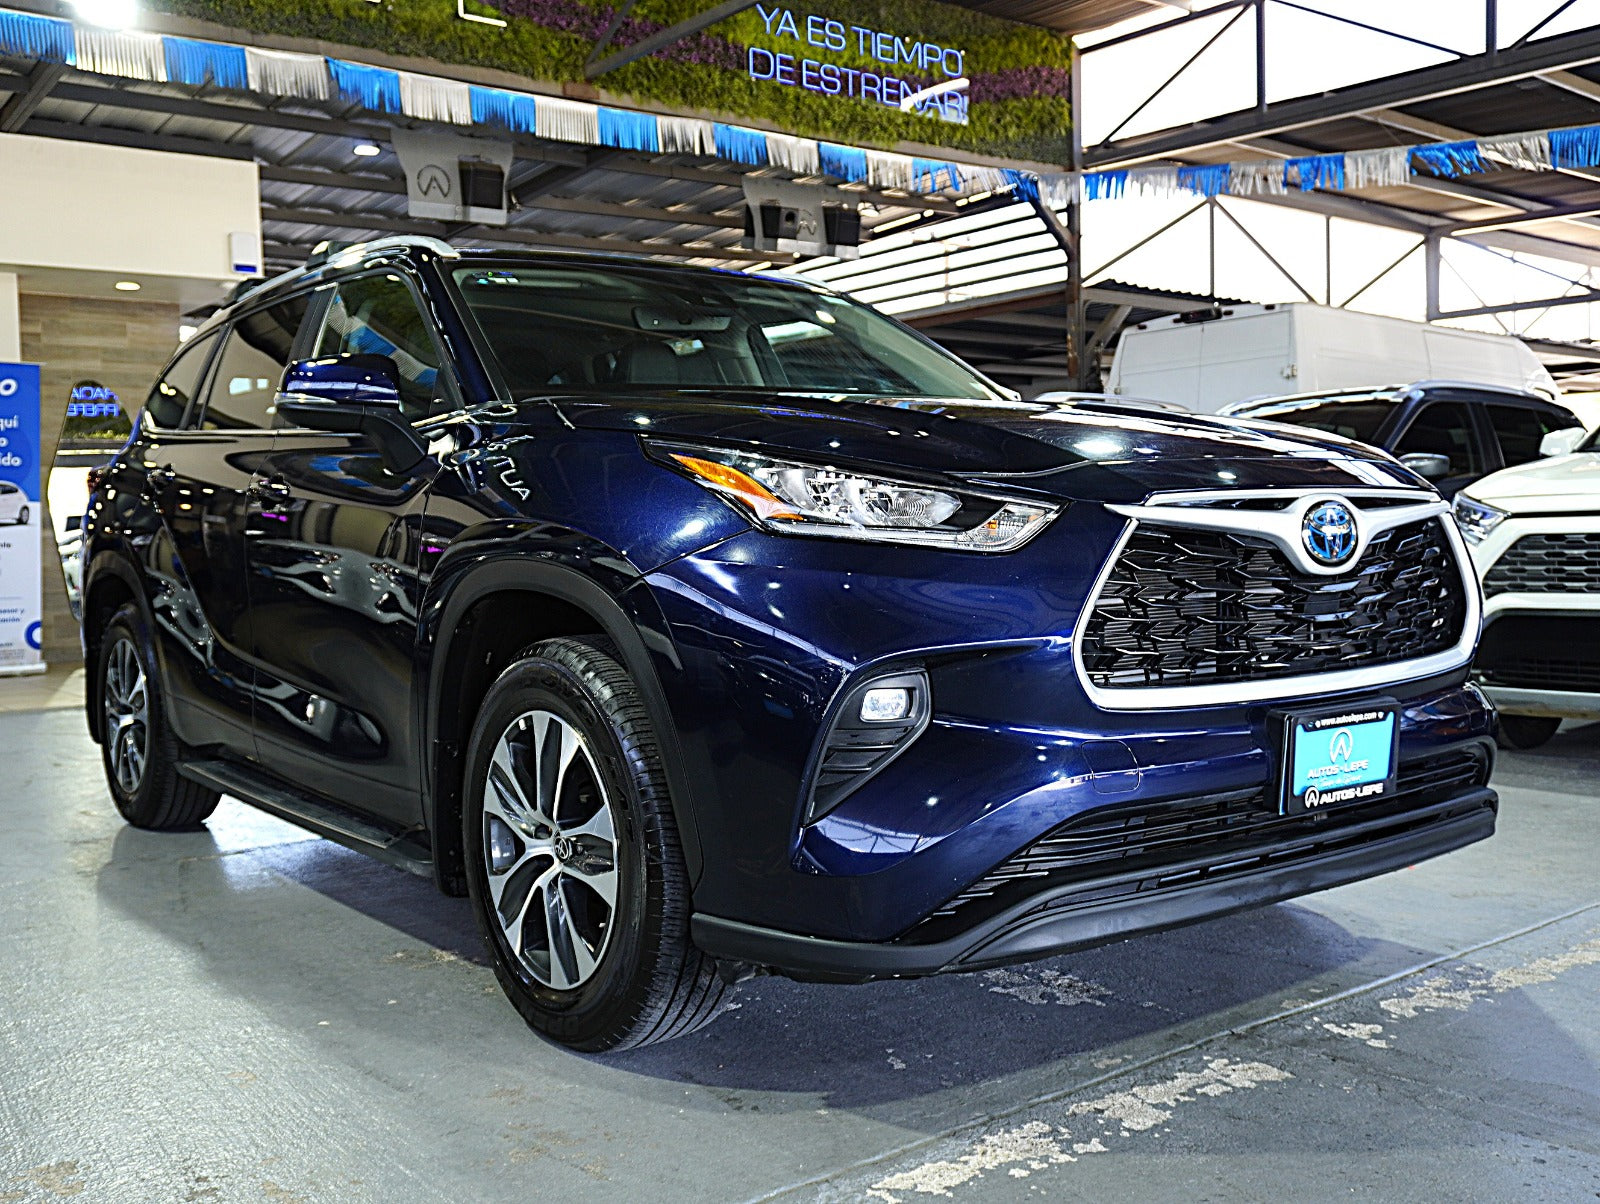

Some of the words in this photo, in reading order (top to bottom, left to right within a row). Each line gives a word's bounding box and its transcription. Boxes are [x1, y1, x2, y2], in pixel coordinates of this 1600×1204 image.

[748, 47, 796, 86] DE
[756, 3, 800, 41] YA
[807, 15, 847, 51] ES
[850, 25, 963, 78] TIEMPO
